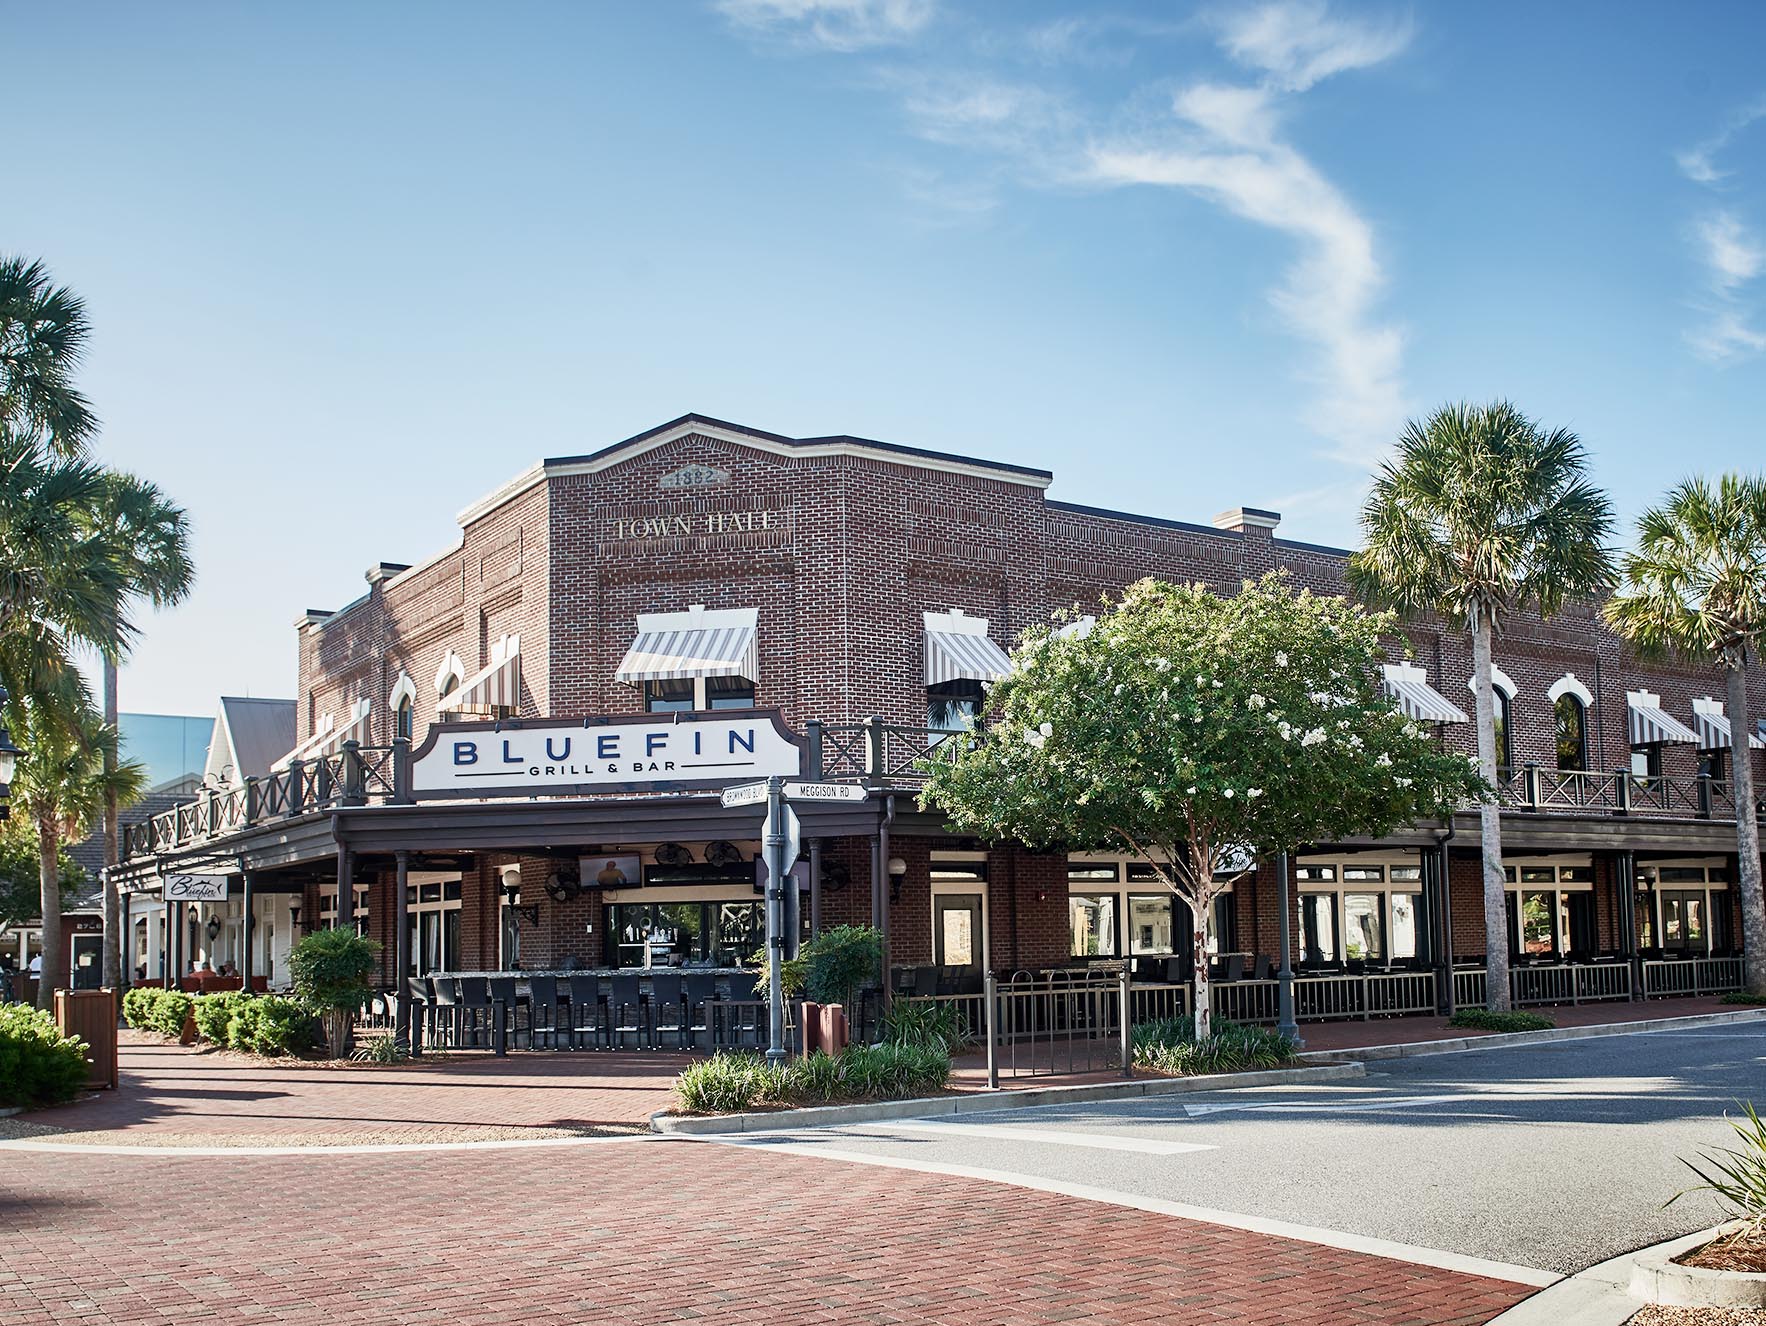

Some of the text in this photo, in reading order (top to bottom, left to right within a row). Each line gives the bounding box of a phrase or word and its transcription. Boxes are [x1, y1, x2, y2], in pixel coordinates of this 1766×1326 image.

[675, 470, 714, 485] 1882
[613, 511, 777, 540] TOWN HALL
[454, 729, 755, 765] BLUEFIN
[529, 761, 676, 776] GRILL & BAR
[800, 785, 850, 798] MEGGISON RD
[170, 875, 216, 900] Bluefin
